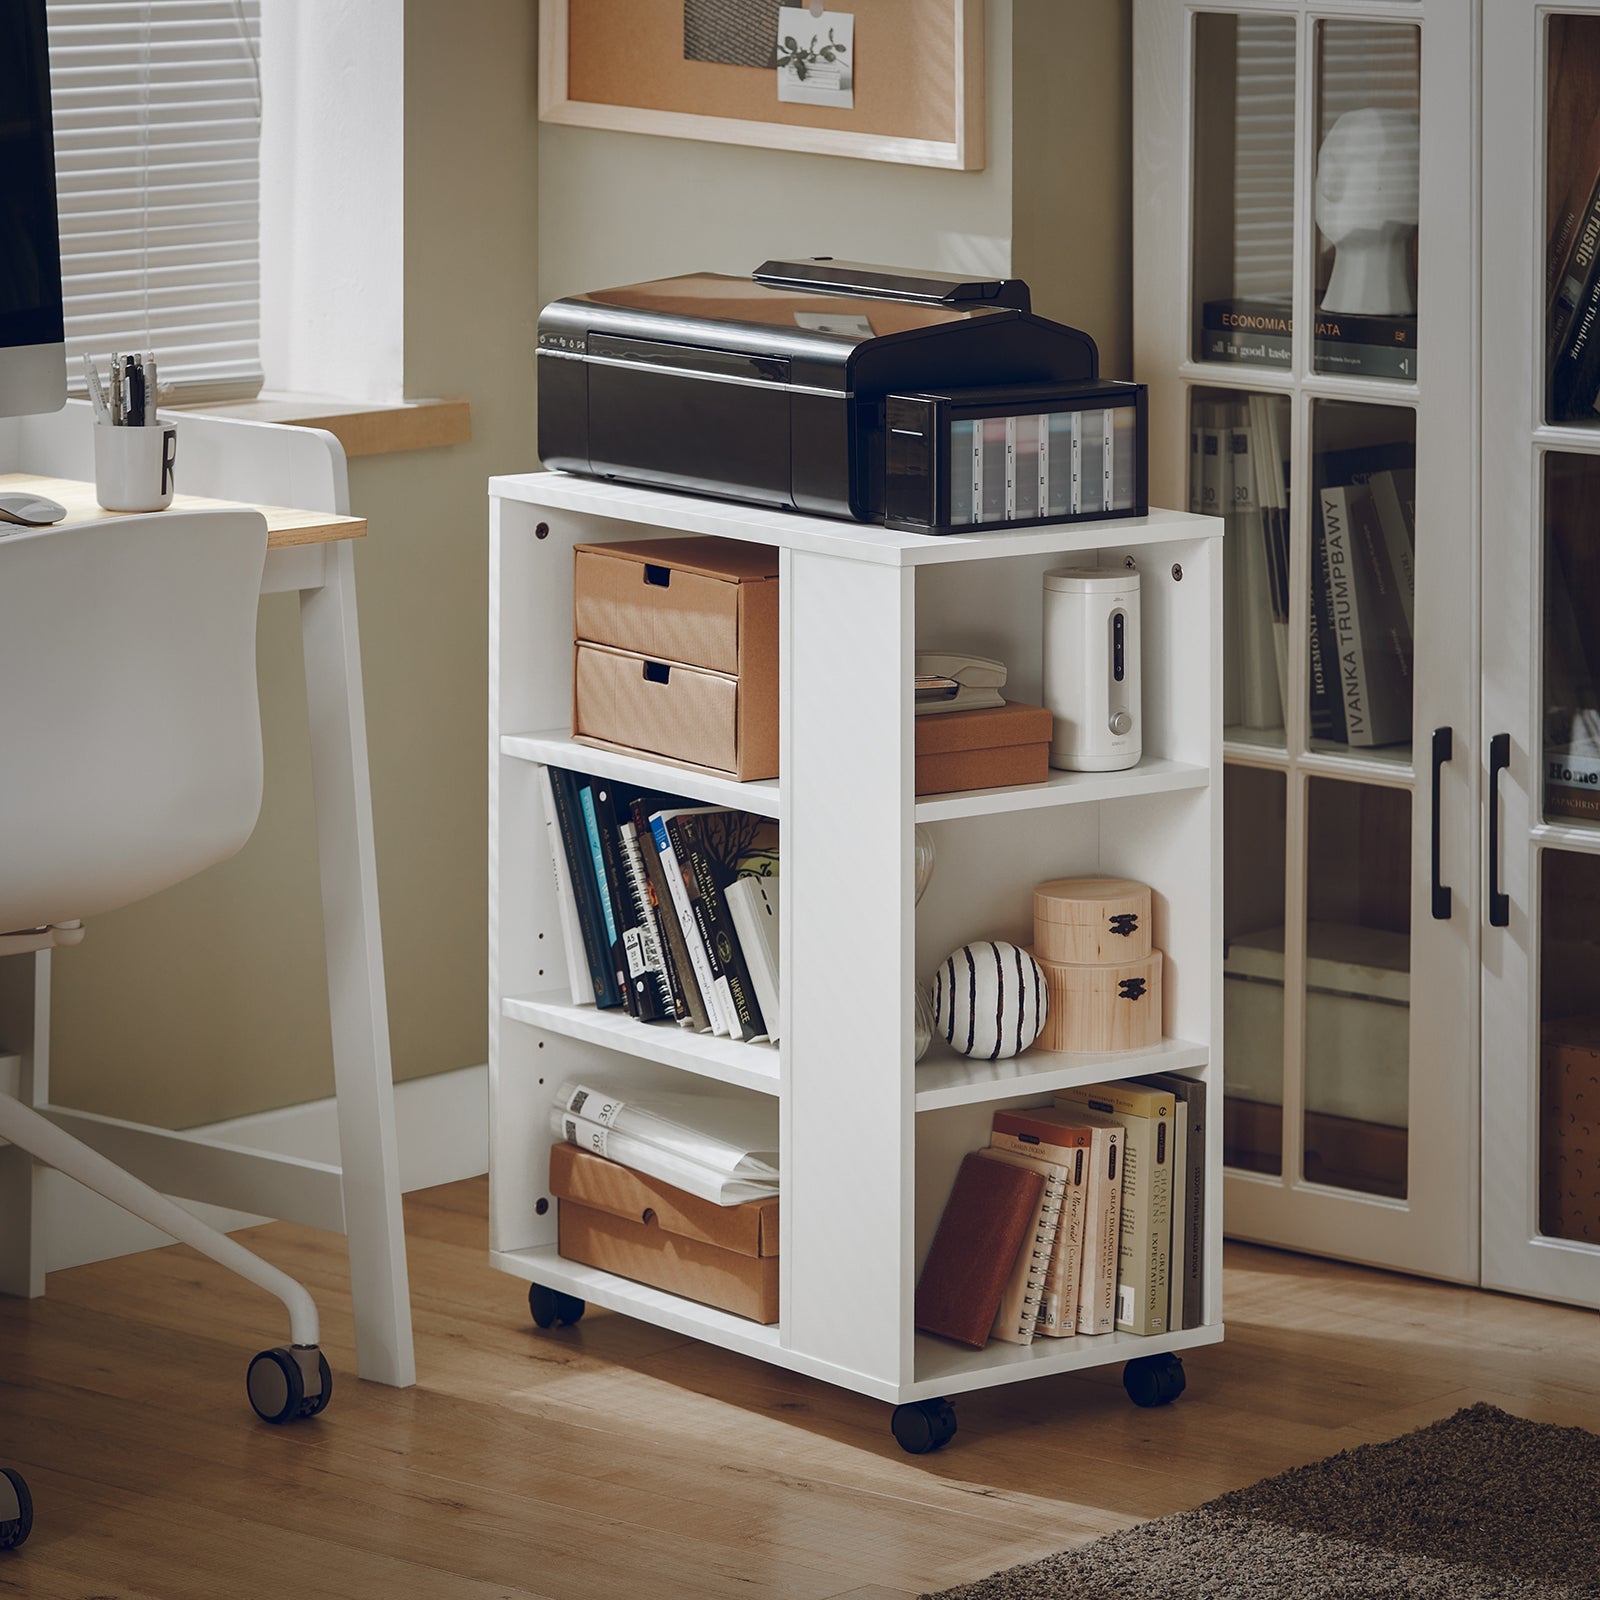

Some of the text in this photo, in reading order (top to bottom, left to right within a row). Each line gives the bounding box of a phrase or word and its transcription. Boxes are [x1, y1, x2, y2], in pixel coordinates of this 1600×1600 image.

[1575, 215, 1600, 266] rustic
[1222, 313, 1287, 332] ECONOMIA
[1570, 307, 1596, 358] Thinking
[1227, 342, 1237, 355] in
[1240, 344, 1266, 358] good
[1268, 347, 1291, 360] taste
[161, 430, 177, 495] R
[1236, 486, 1248, 500] 30
[1343, 650, 1363, 733] IVANKA
[1550, 763, 1598, 784] Home
[691, 852, 715, 921] Mockingbird
[700, 859, 708, 874] To
[705, 875, 715, 896] Kill
[695, 905, 707, 939] SOLOMON
[729, 976, 750, 1023] HARPER LEE
[599, 1104, 612, 1121] 30
[592, 1134, 600, 1152] 30
[1070, 1190, 1081, 1217] Oliver
[1151, 1170, 1161, 1224] DICKENS
[1159, 1168, 1168, 1224] CHARLES
[1069, 1218, 1079, 1242] Twist
[1066, 1248, 1074, 1281] CHARLES
[1106, 1268, 1112, 1278] OF
[1149, 1232, 1158, 1310] EXPECTATIONS
[1063, 1284, 1072, 1317] DICKENS
